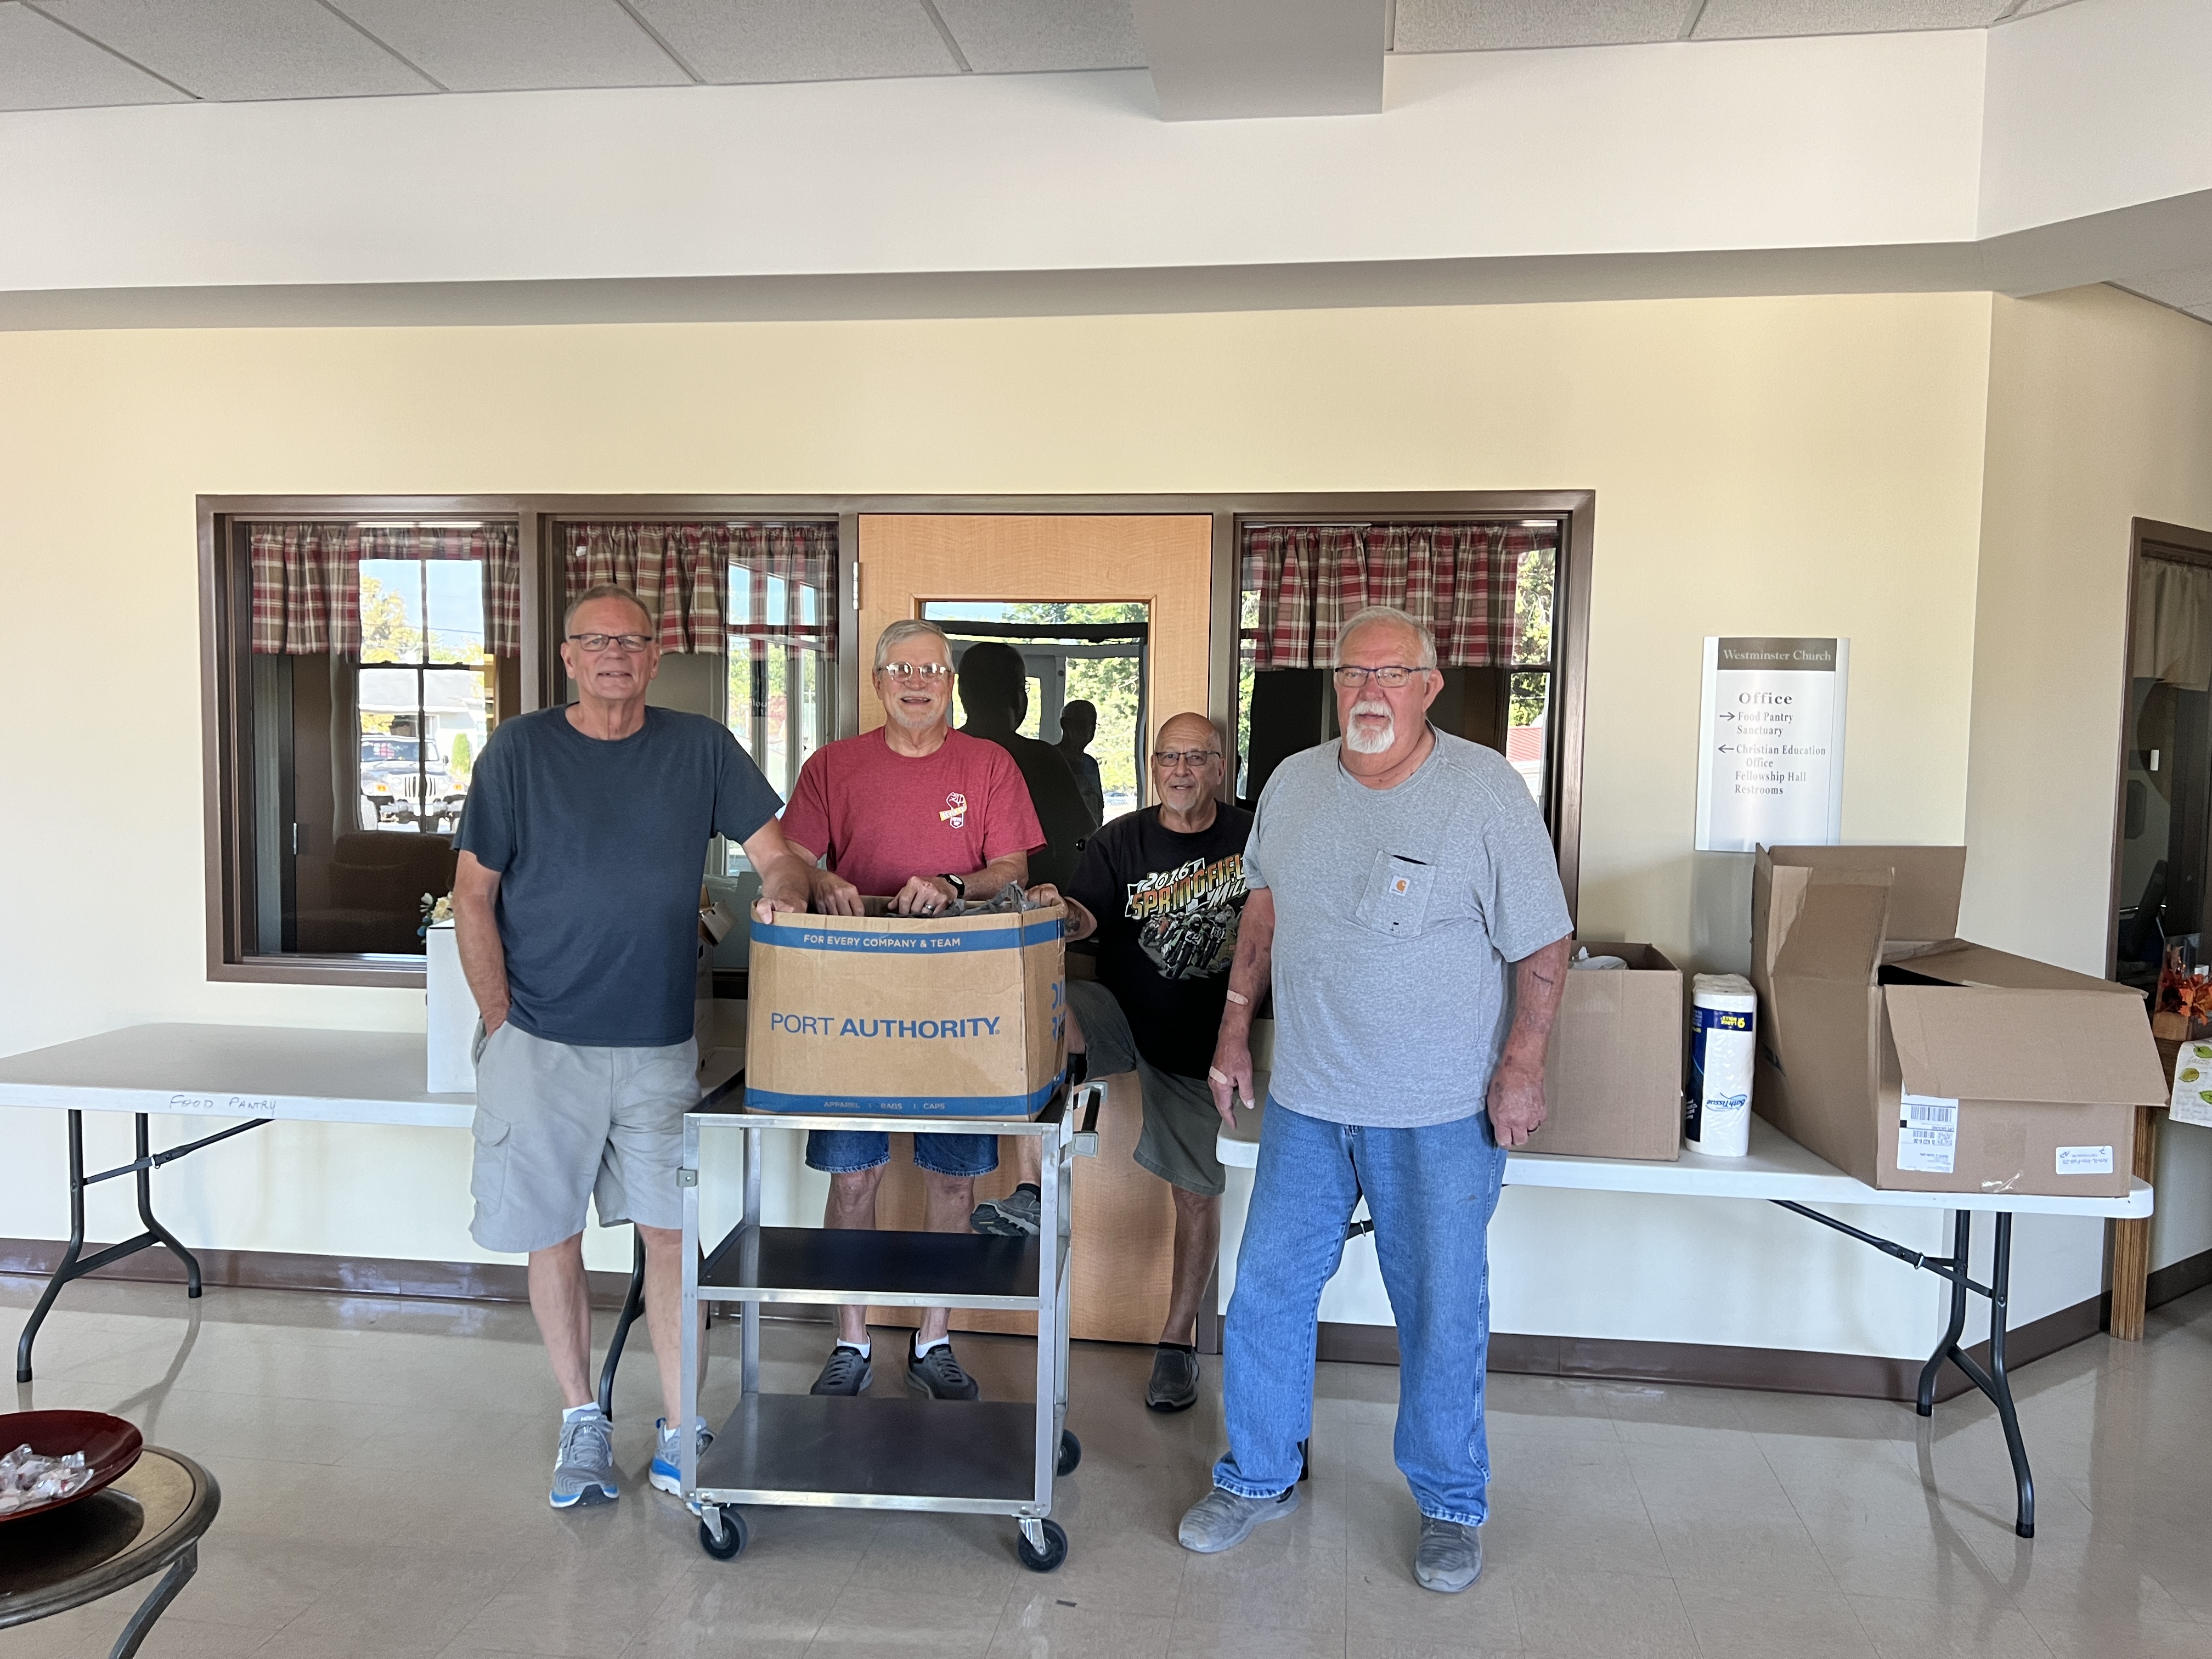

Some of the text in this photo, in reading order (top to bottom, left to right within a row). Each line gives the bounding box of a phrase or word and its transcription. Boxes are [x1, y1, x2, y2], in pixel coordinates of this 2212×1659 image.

[1723, 648, 1831, 661] Westminster Church
[1739, 692, 1793, 705] Office
[1737, 712, 1793, 724] Food Pantry
[1736, 725, 1784, 737] Sanctuary
[1736, 743, 1826, 755] Christian Education
[1746, 757, 1774, 768] Office
[1735, 771, 1807, 783] Fellowship Hall
[1735, 784, 1784, 795] Restrooms
[1141, 861, 1190, 891] 2016
[1131, 853, 1246, 921] SPRINGFIEL
[804, 934, 961, 948] FOR EVERY COMPANY & TEAM
[771, 1012, 835, 1035] PORT
[1737, 1017, 1746, 1029] 9
[170, 1094, 276, 1118] FOOD PANTRY
[1729, 1099, 1746, 1108] Bath
